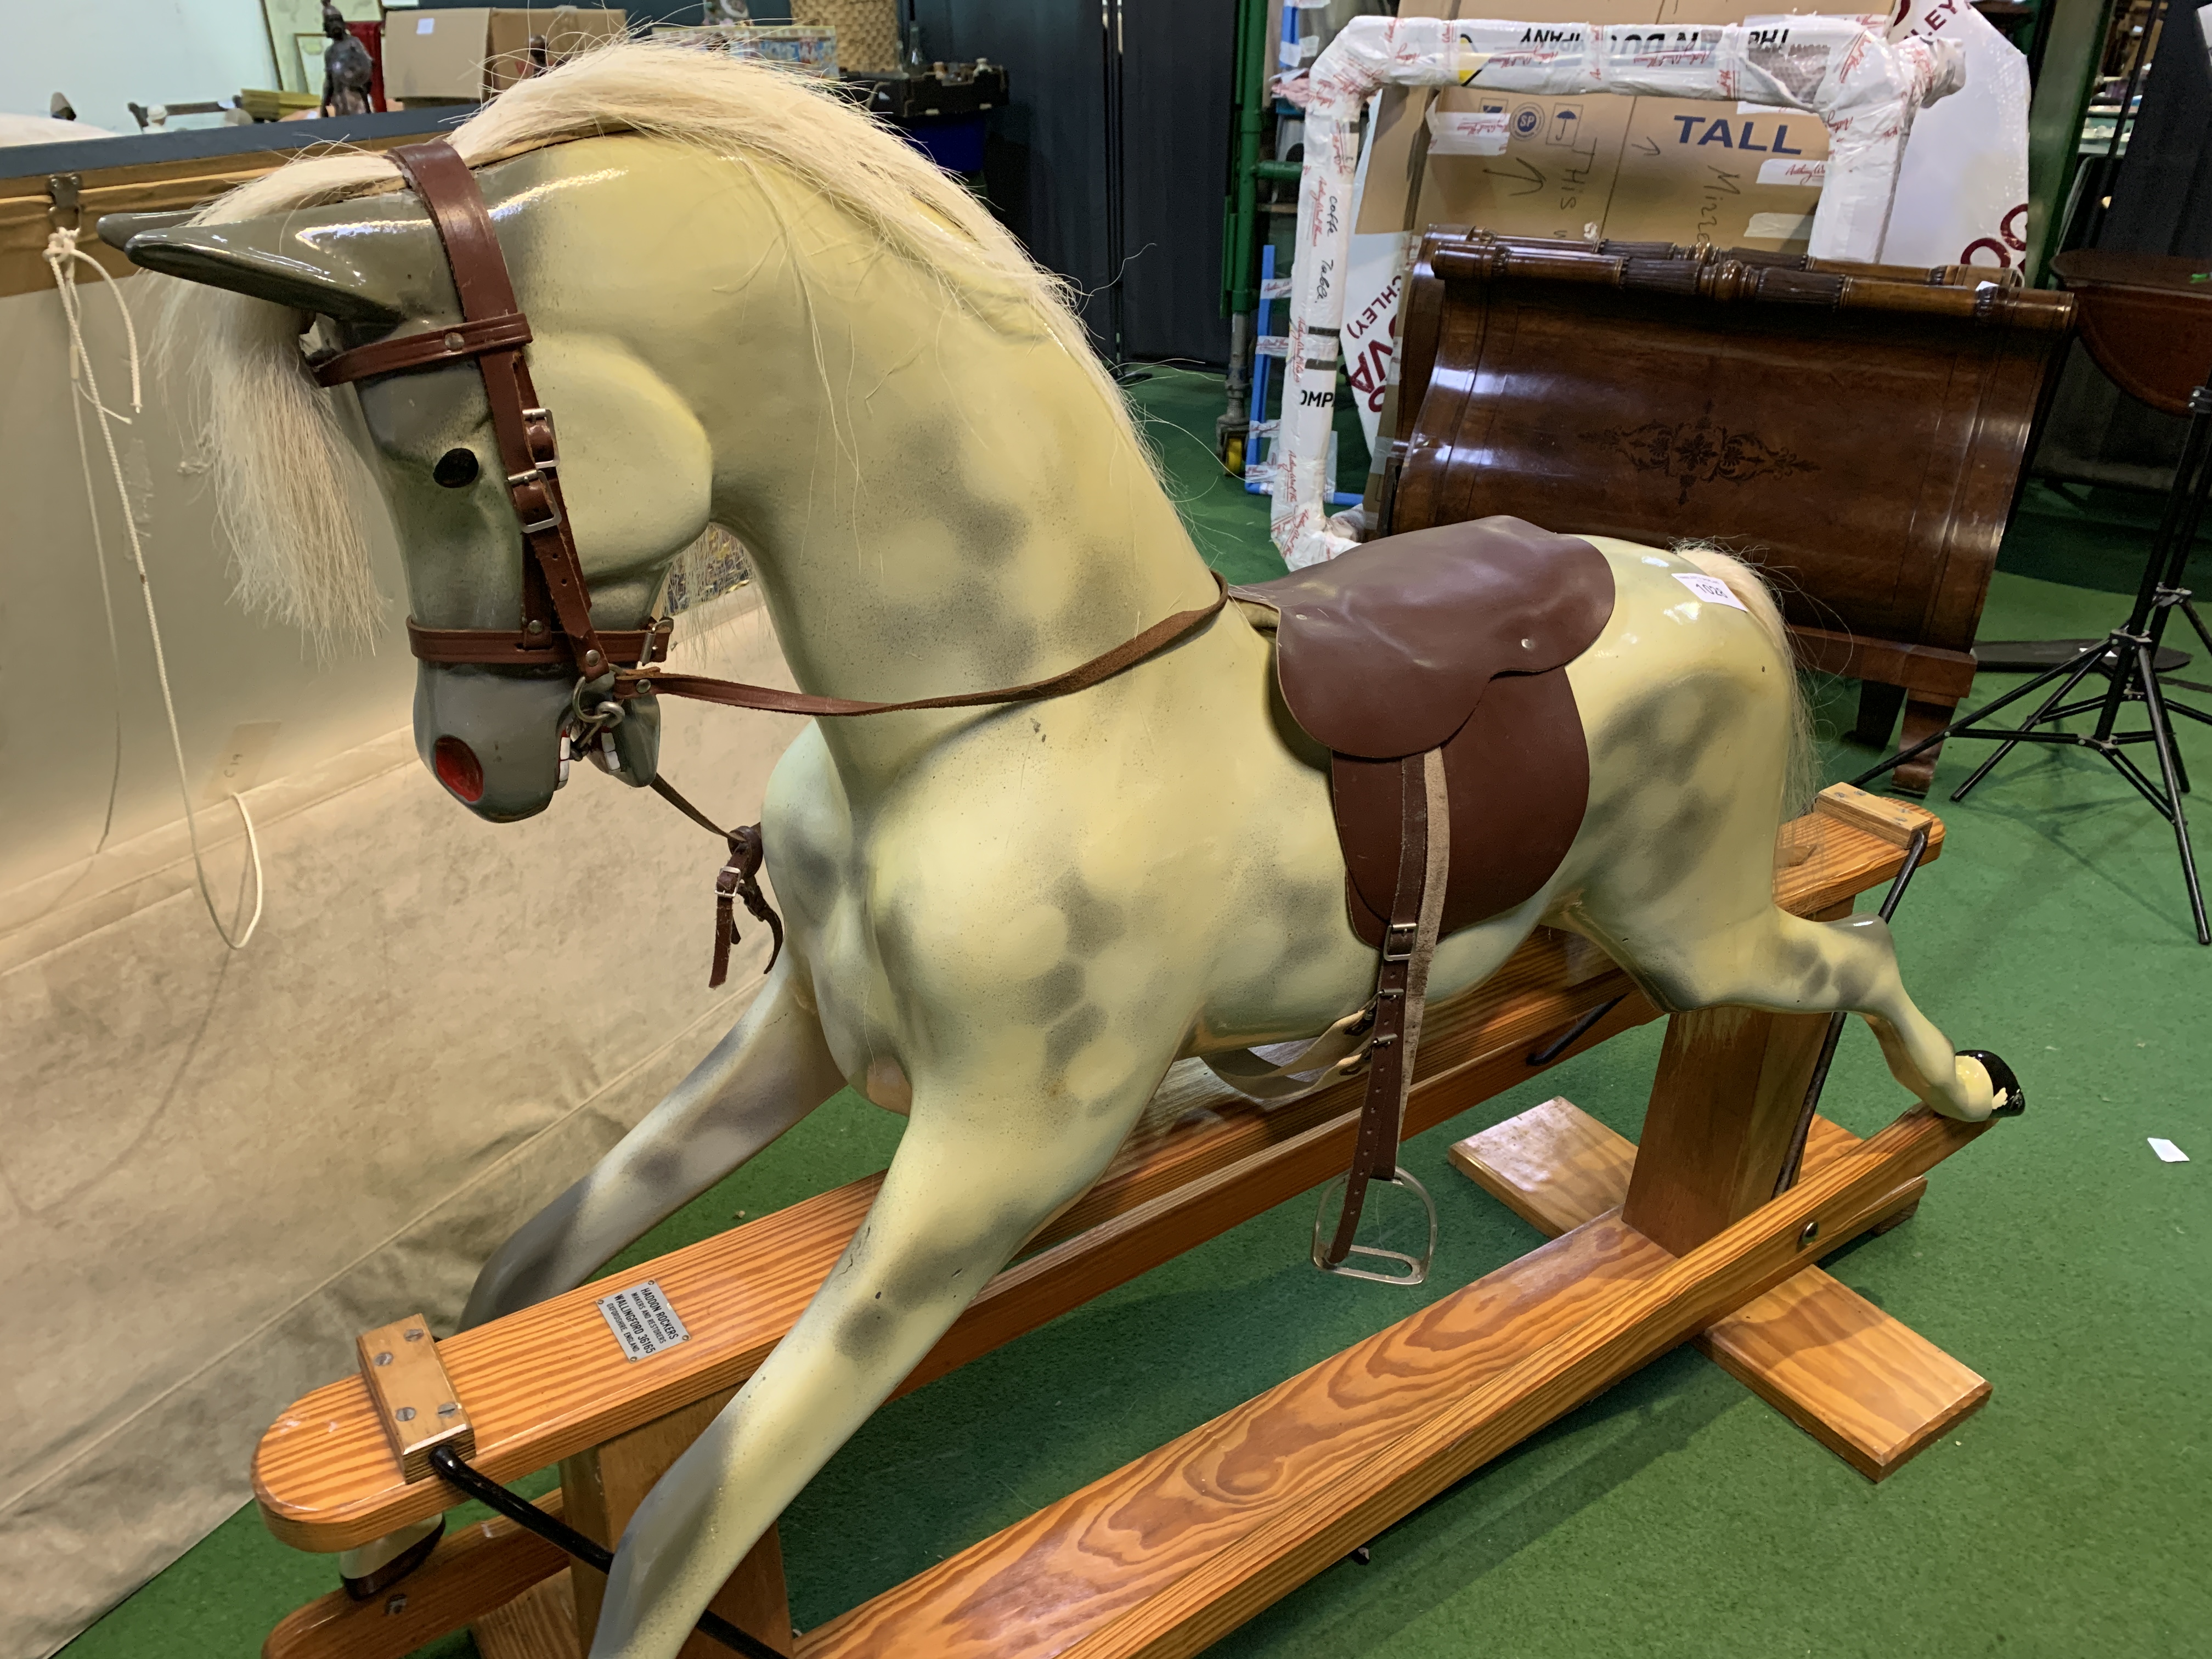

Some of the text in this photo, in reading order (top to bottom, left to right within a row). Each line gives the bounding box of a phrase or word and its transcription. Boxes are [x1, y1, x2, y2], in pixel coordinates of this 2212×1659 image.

[1674, 115, 1802, 155] TALL
[1696, 583, 1728, 599] 1028
[614, 1294, 656, 1354] WALLINGFORD 36165
[631, 1292, 667, 1344] MAKERS AND RESTORERS
[640, 1288, 679, 1339] HADDON ROCKERS
